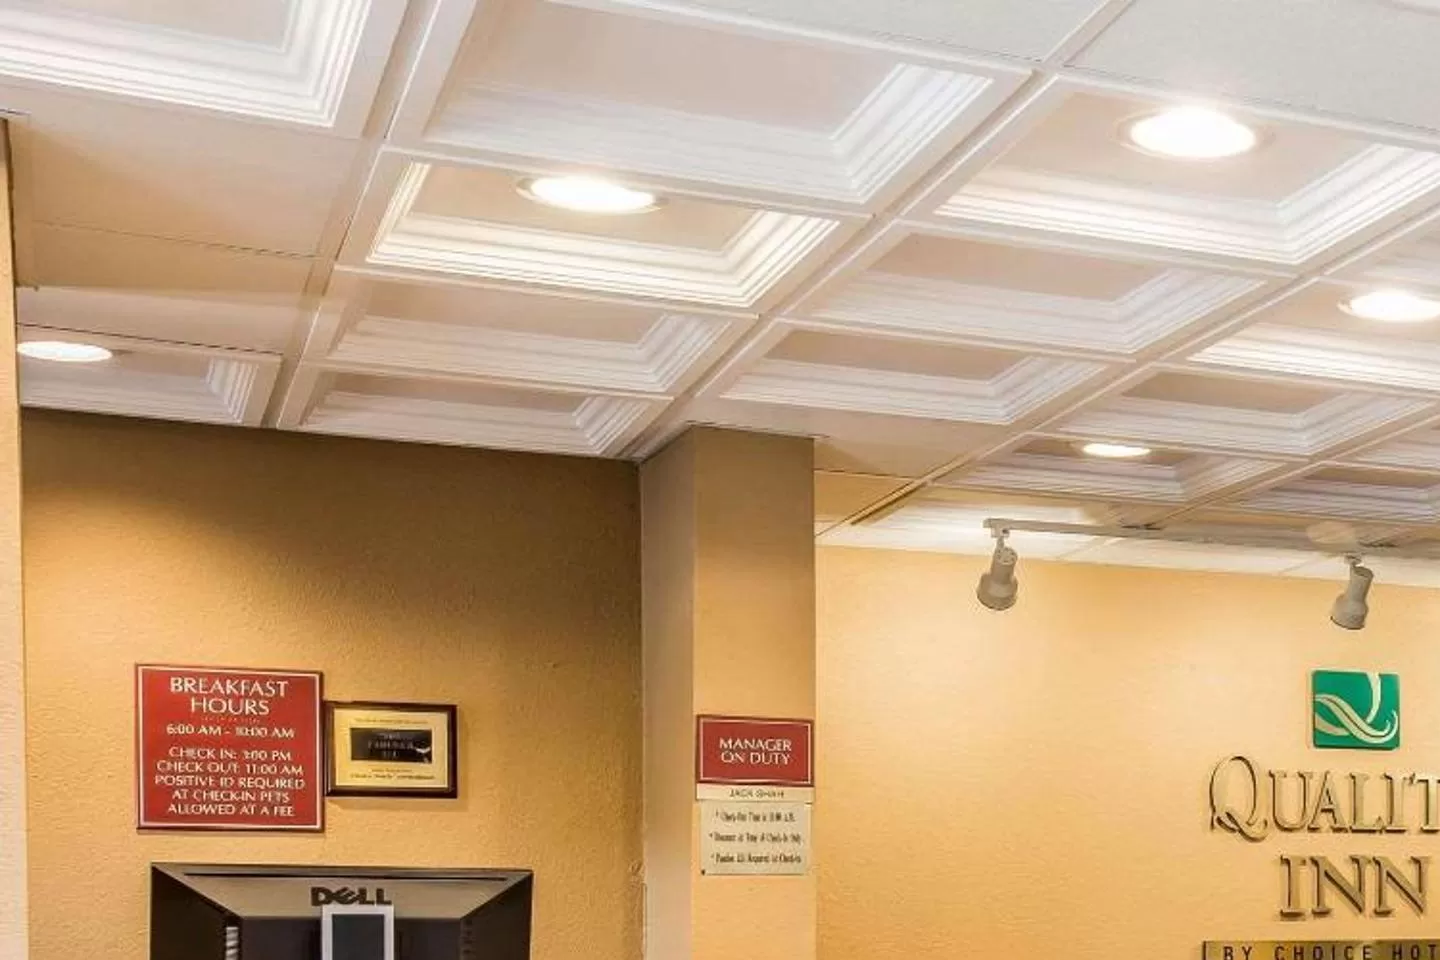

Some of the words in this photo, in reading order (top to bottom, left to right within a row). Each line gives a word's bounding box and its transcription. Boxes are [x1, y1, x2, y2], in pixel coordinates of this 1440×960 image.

[170, 676, 289, 697] BREAKFAST
[191, 697, 270, 715] HOURS
[198, 725, 222, 736] AM
[272, 727, 295, 738] AM
[719, 738, 792, 752] MANAGER
[168, 746, 216, 759] CHECK
[272, 750, 292, 761] PM
[721, 750, 745, 763] ON
[751, 752, 791, 765] DUTY
[156, 760, 204, 772] CHECK
[246, 763, 278, 775] 11:00
[281, 764, 304, 776] AM
[155, 774, 216, 787] POSITIVE
[238, 777, 306, 790] REQUIRED
[172, 789, 189, 800] AT
[260, 791, 291, 803] PETS
[168, 803, 236, 815] ALLOWED
[240, 804, 257, 815] AT
[260, 805, 270, 816] A
[274, 805, 296, 817] FEE
[1279, 855, 1432, 919] INN
[311, 886, 392, 906] DELL
